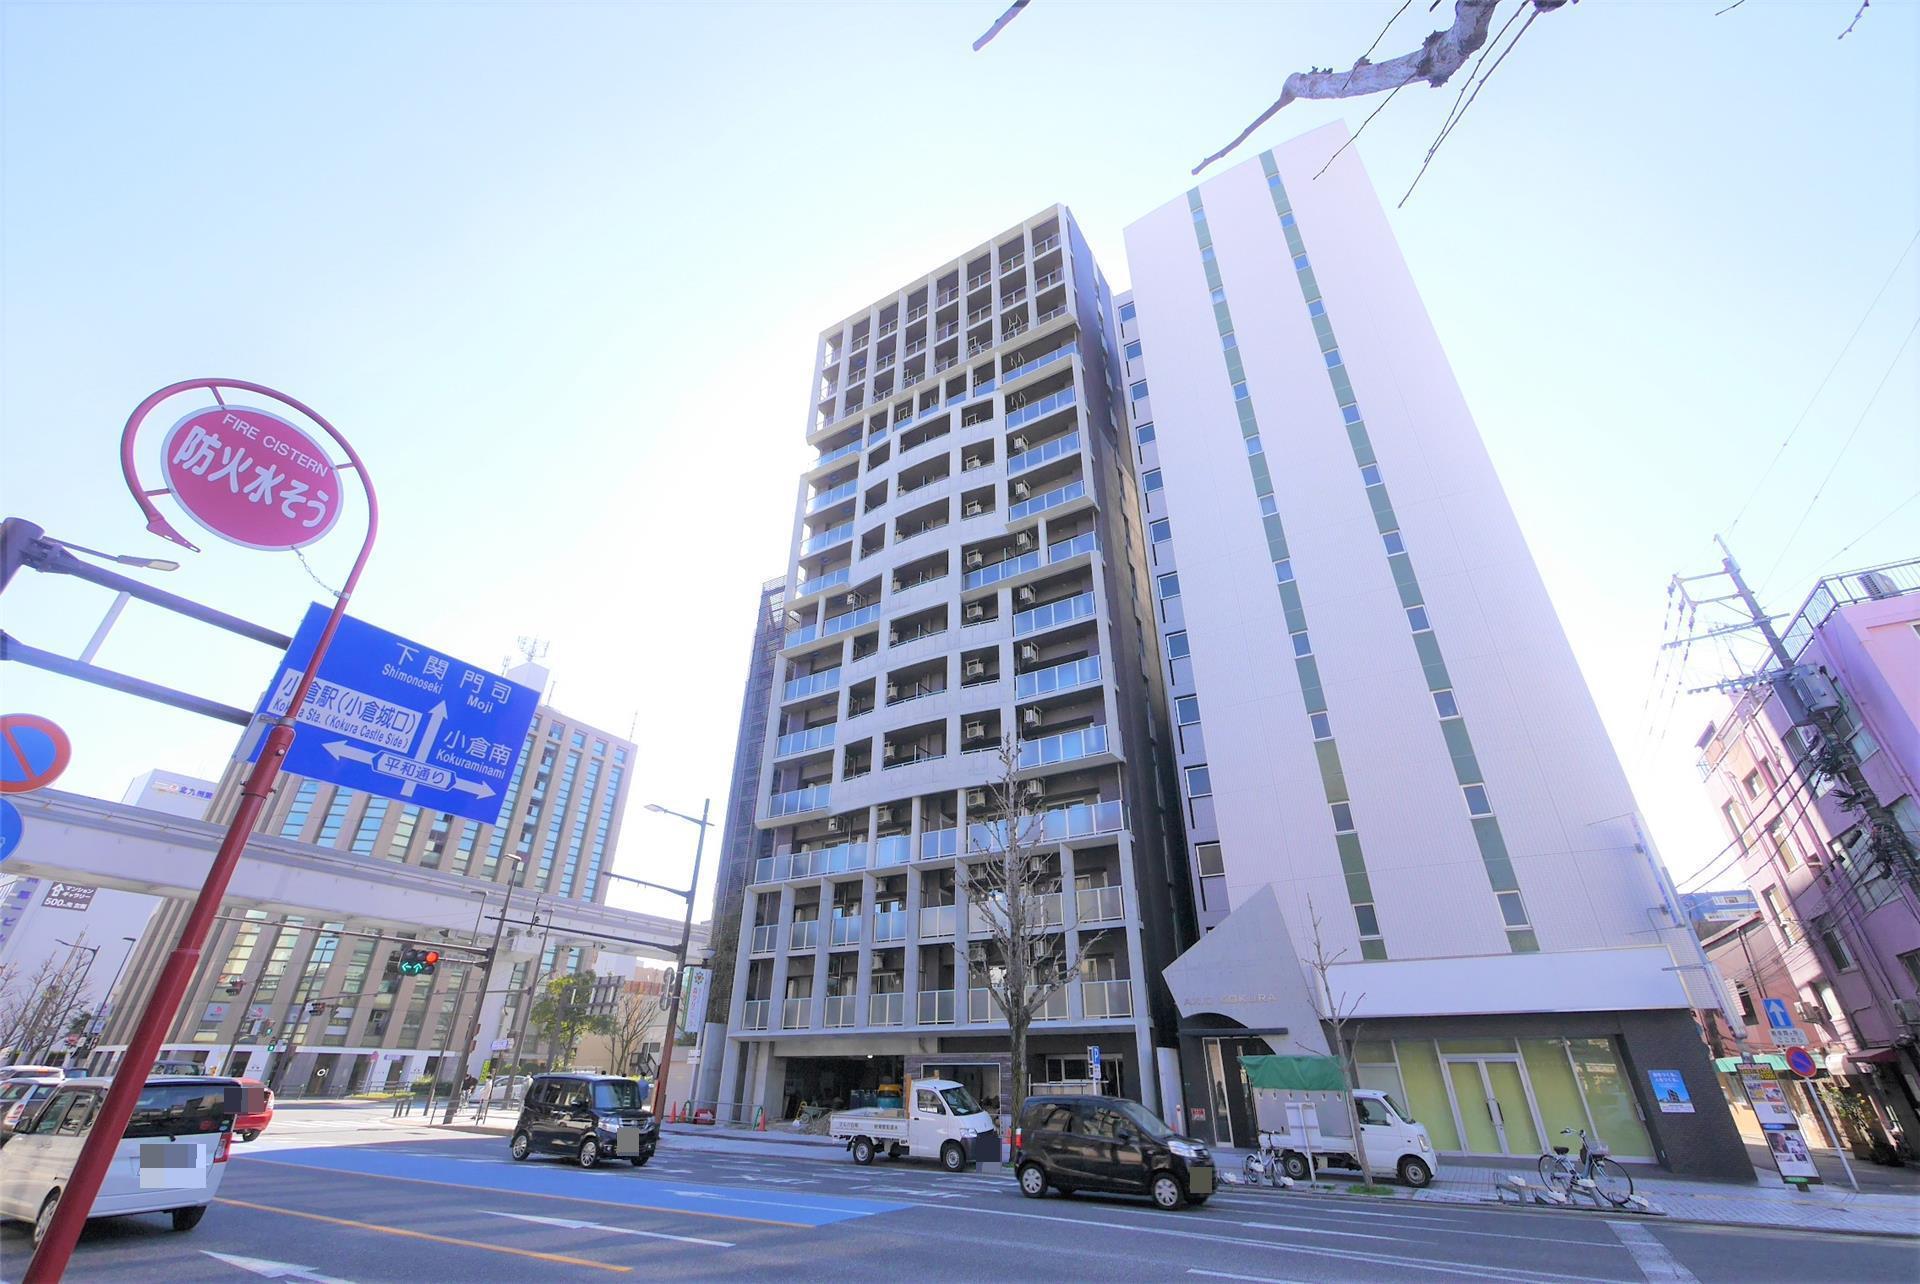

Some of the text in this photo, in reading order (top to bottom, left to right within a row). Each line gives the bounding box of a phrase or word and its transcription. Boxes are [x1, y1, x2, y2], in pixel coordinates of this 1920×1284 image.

[222, 413, 329, 477] FIRE CISTERN
[172, 425, 329, 528] 防火水そう
[381, 663, 494, 714] Shimonoseki Moji
[396, 642, 512, 705] 下関 門司
[360, 724, 384, 743] Castle
[443, 730, 513, 766] 小倉南
[384, 756, 446, 786] 平和通り
[436, 748, 506, 780] Kokuraminami
